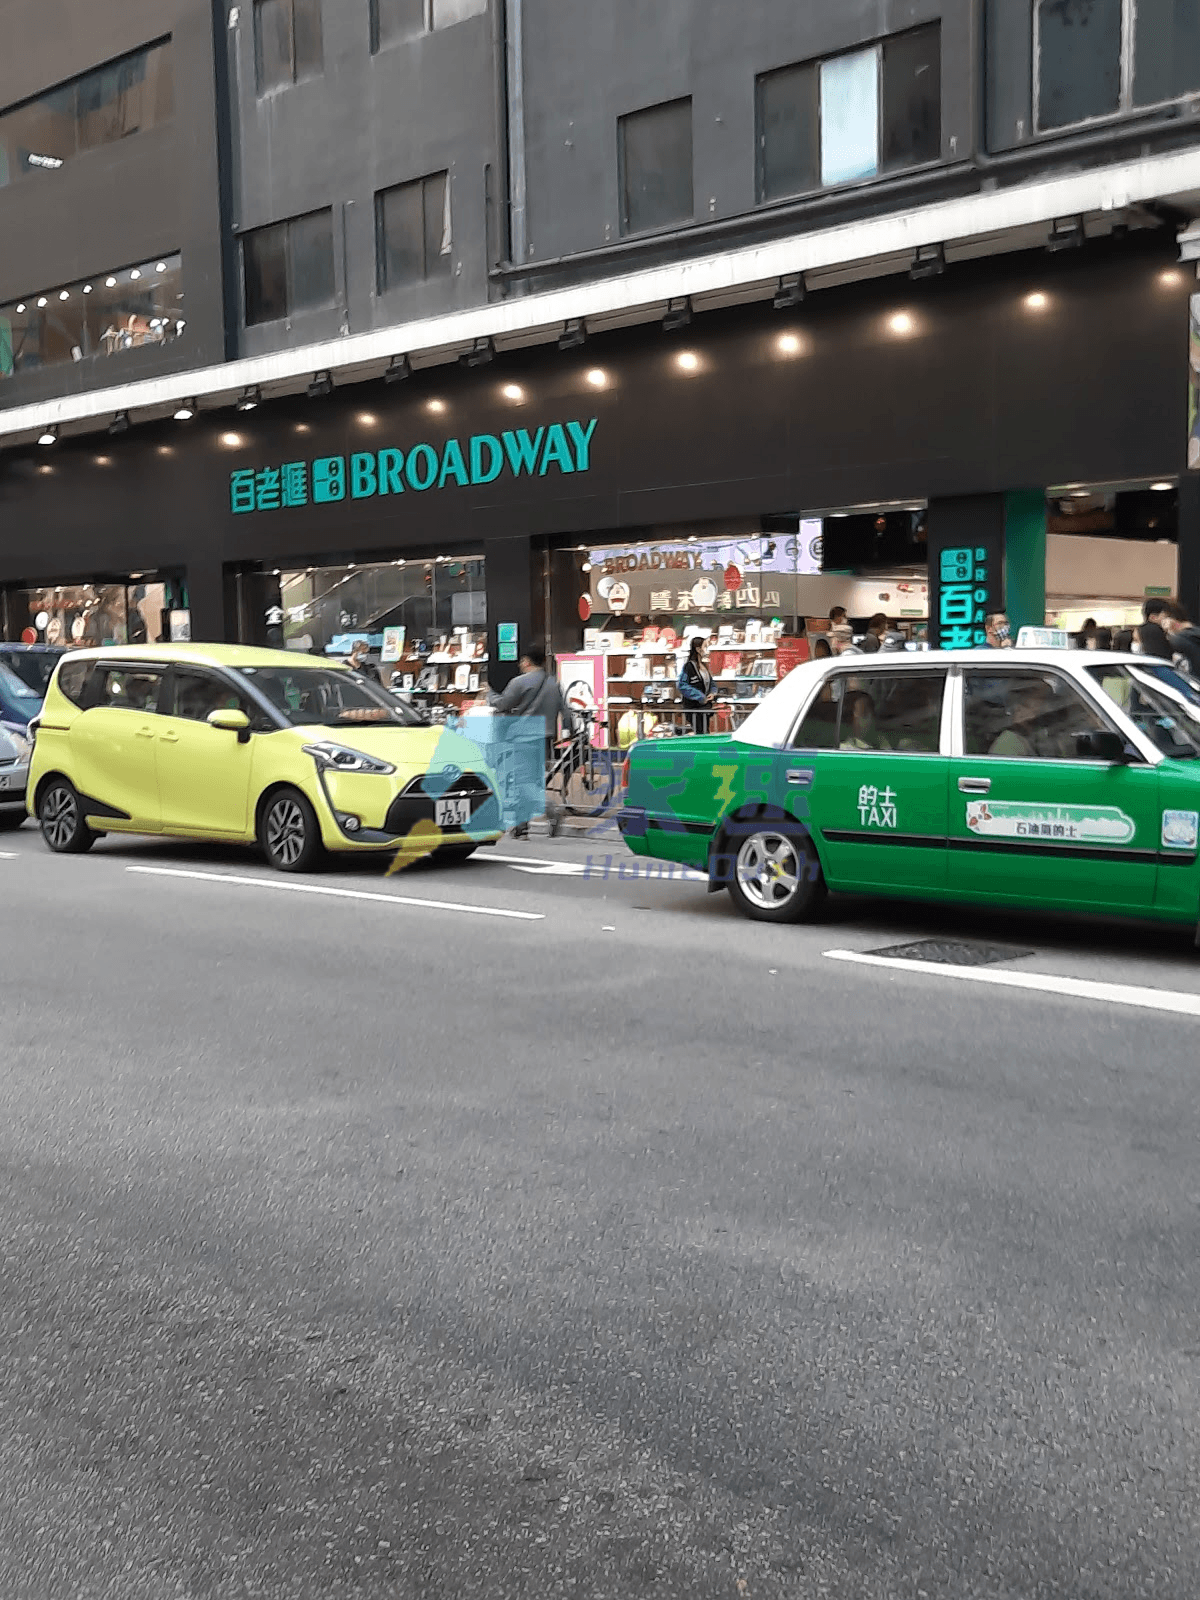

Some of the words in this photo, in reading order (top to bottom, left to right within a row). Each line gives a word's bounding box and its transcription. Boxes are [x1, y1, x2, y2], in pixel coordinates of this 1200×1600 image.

[351, 418, 598, 499] BROADWAY
[604, 551, 701, 574] BROADWAY
[858, 785, 897, 807] 的士
[857, 806, 897, 828] TAXI
